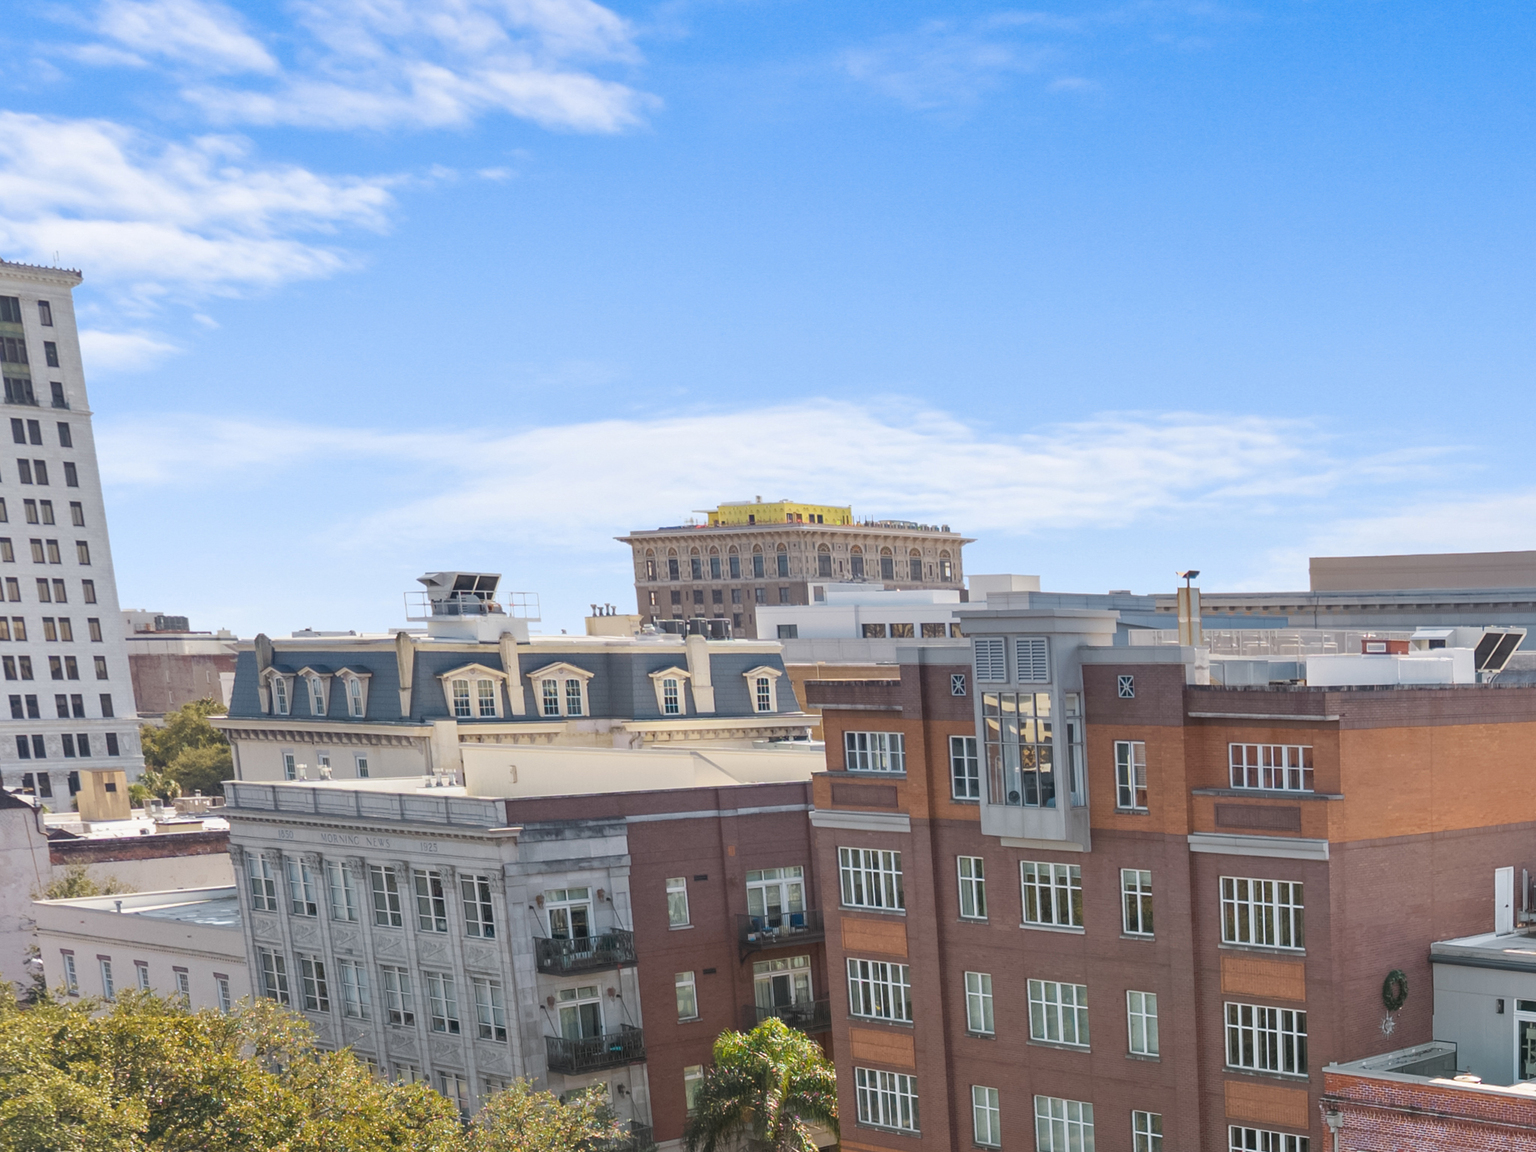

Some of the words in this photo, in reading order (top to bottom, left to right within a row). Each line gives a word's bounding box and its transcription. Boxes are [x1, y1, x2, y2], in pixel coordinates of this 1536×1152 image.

[278, 829, 294, 839] 1850
[320, 832, 360, 846] MORNING
[366, 837, 391, 848] NEWS
